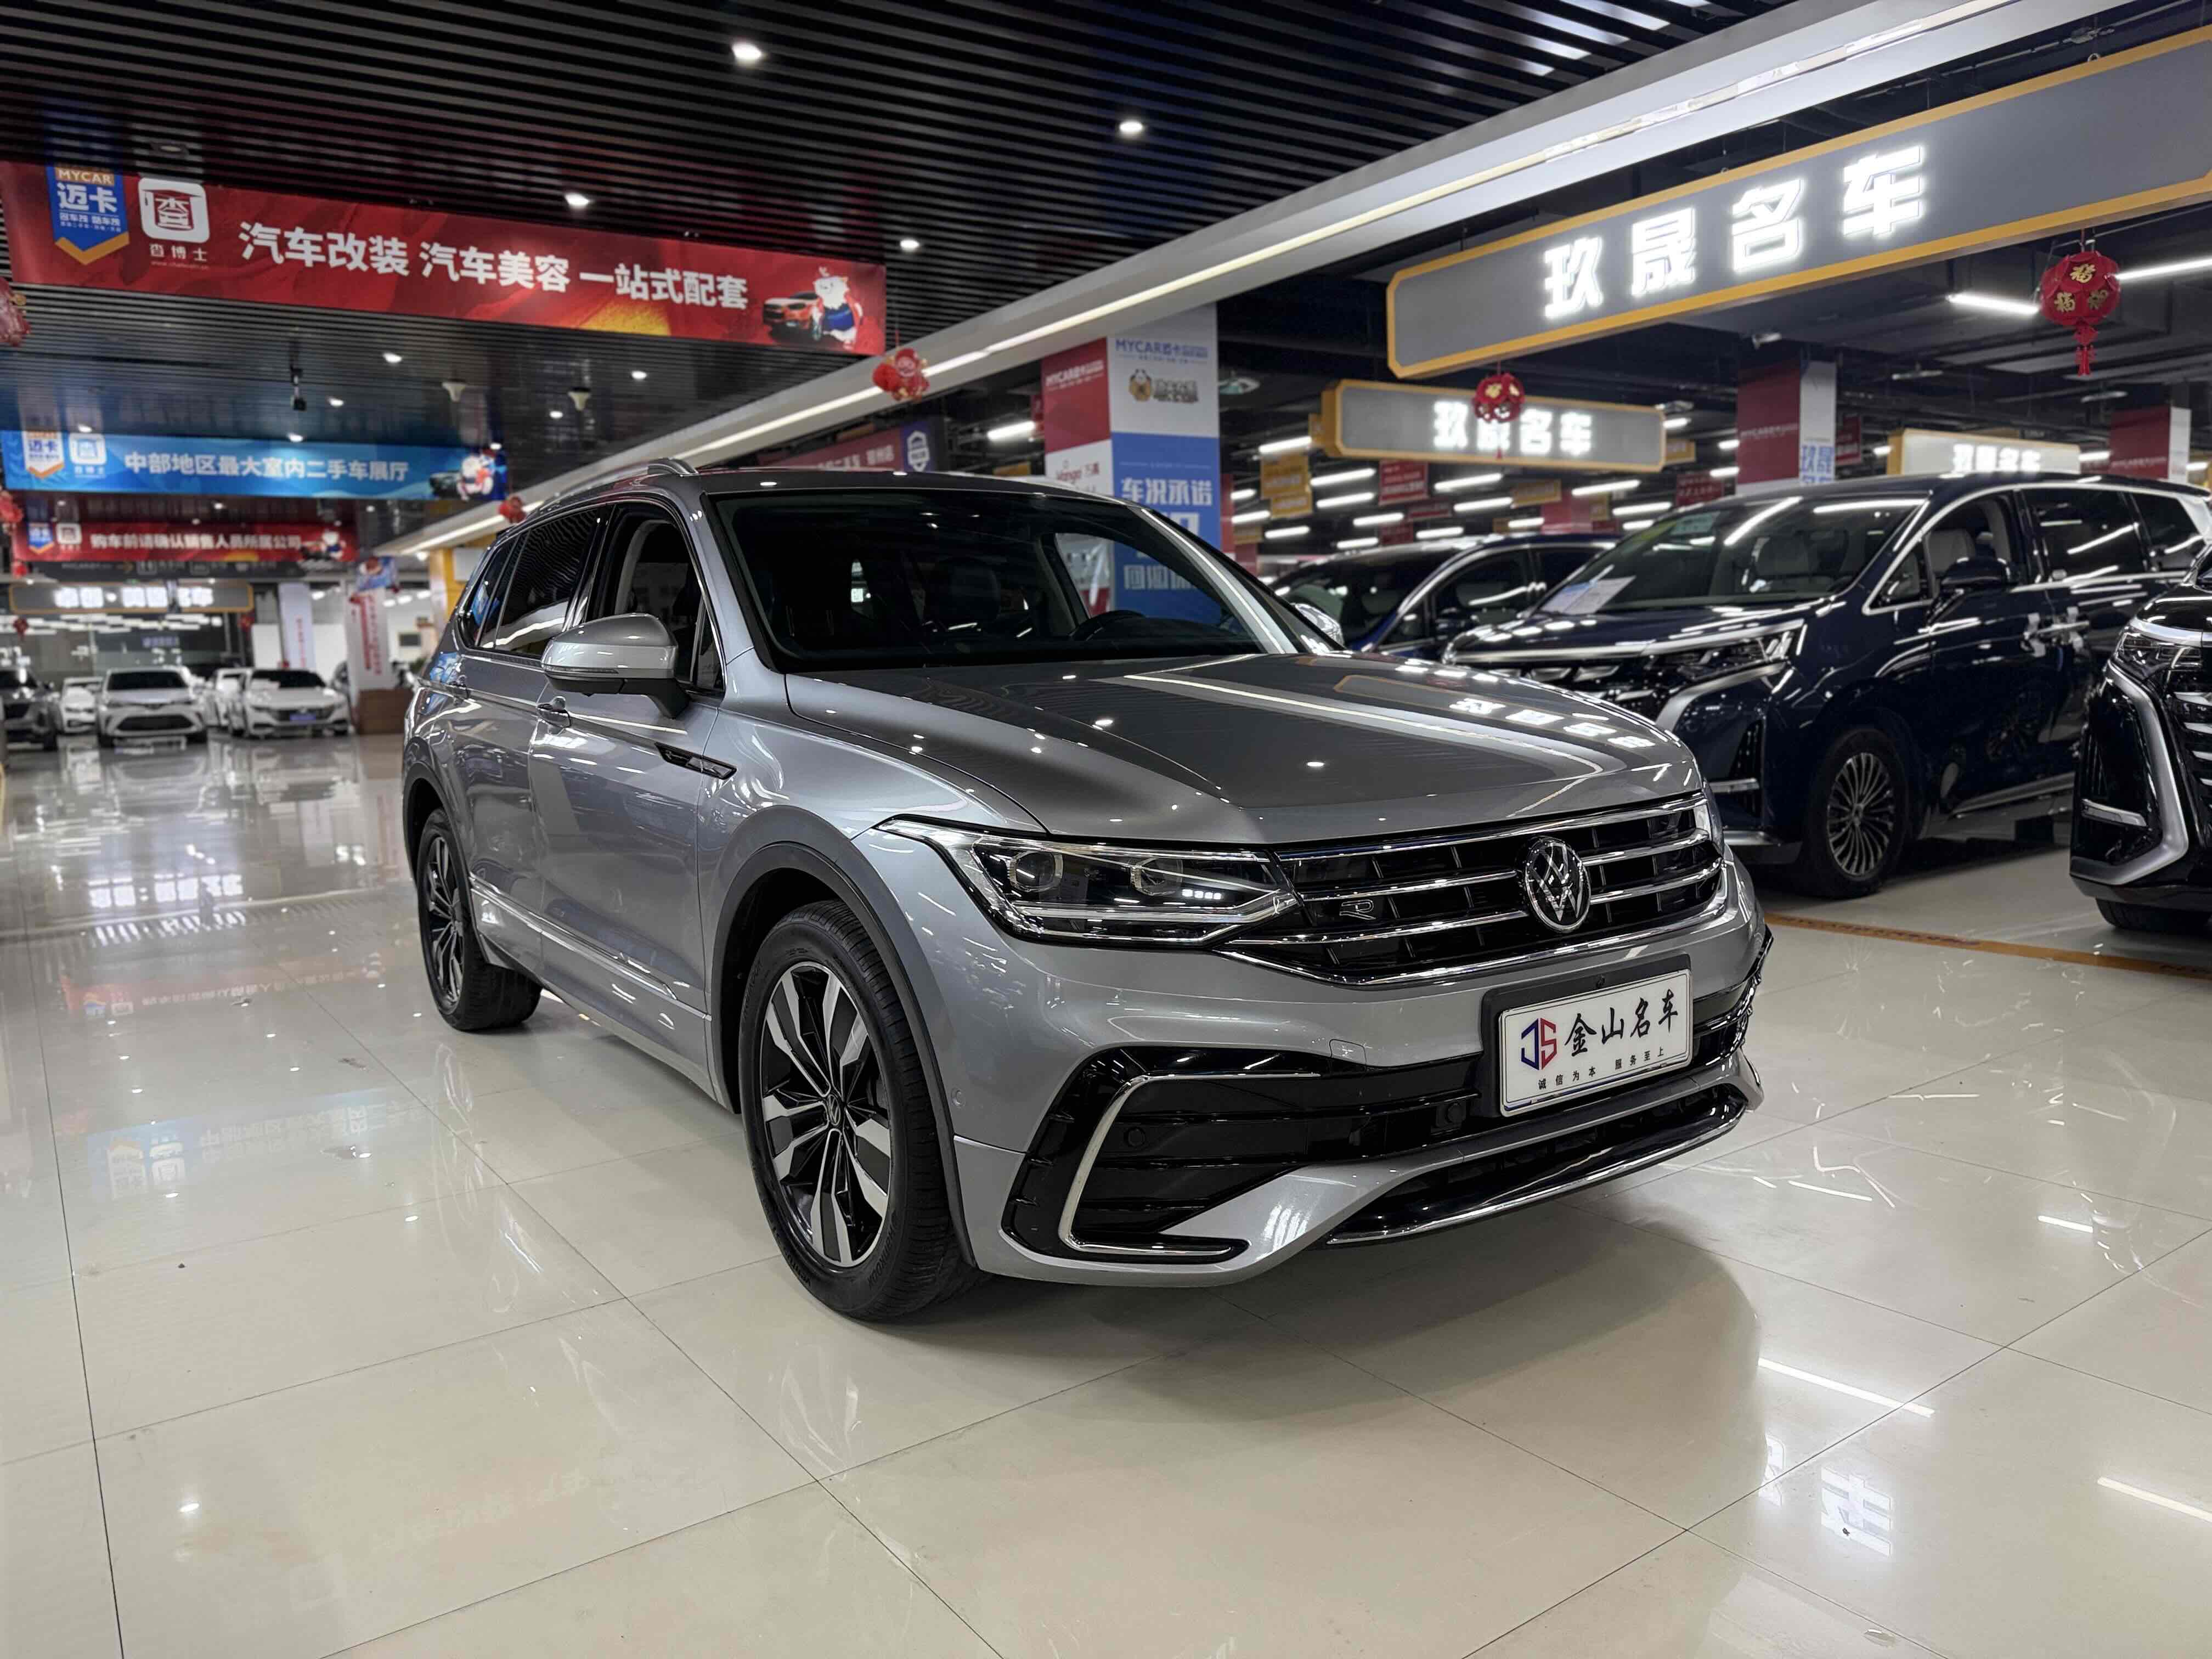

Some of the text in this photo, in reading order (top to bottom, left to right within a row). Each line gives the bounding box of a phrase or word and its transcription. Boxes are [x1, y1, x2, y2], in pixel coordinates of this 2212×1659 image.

[57, 169, 111, 184] MYCAR
[57, 182, 117, 213] 迈卡
[1543, 145, 1925, 320] 玖晟名车
[238, 221, 749, 311] 汽车改装 汽车美容 一站式配套
[125, 450, 409, 483] 中部地区最大室内二手车展厅
[1121, 477, 1212, 506] 车况承诺
[1564, 988, 1679, 1057] 金山名车
[1538, 1046, 1665, 1091] 诚信为本 服务至上
